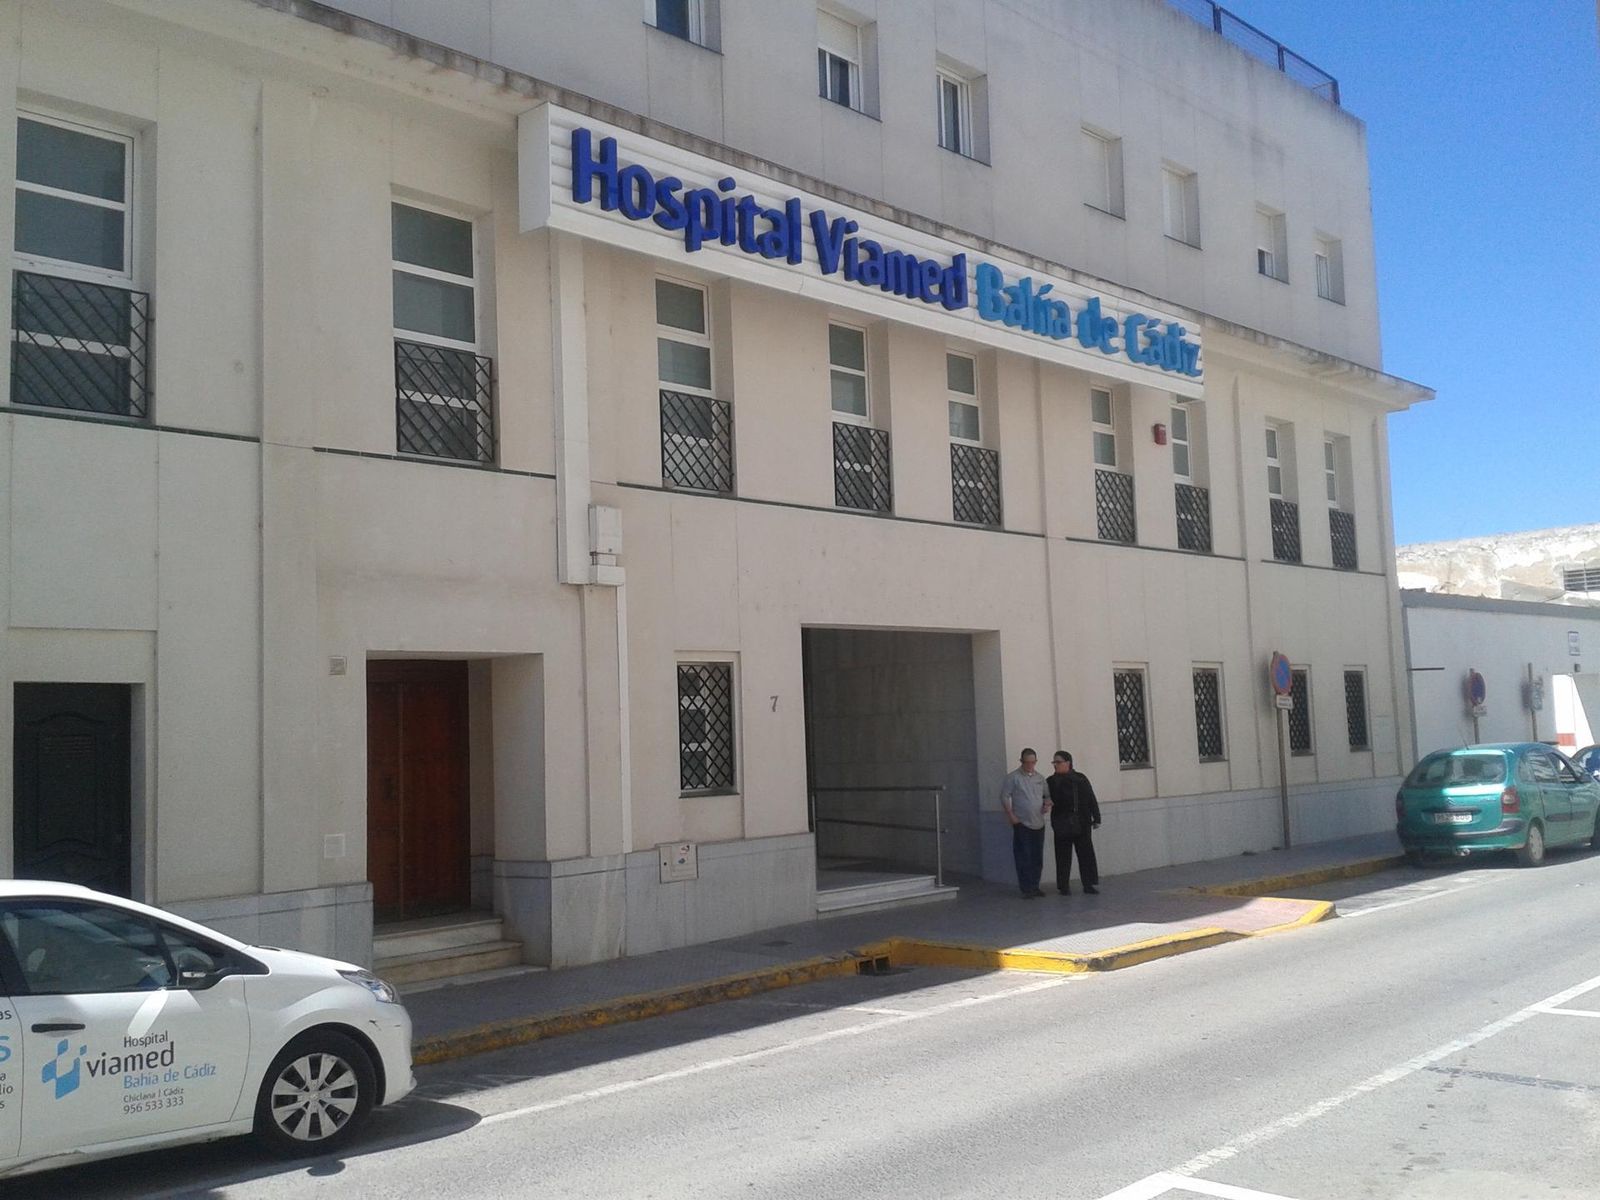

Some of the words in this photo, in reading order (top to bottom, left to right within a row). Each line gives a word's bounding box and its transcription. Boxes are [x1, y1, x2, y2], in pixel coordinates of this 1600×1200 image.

[571, 127, 802, 265] Hospital
[809, 209, 968, 311] Viamed
[975, 262, 1072, 340] Bahía
[1076, 297, 1120, 354] de
[1123, 313, 1203, 377] Cádiz
[769, 695, 779, 713] 7
[123, 1030, 169, 1049] Hospital
[86, 1041, 175, 1078] viamed
[163, 1068, 180, 1083] de
[184, 1063, 217, 1080] Cádiz
[123, 1092, 156, 1104] Chiclana
[123, 1102, 143, 1115] 956
[145, 1098, 164, 1112] 533
[166, 1095, 185, 1109] 333
